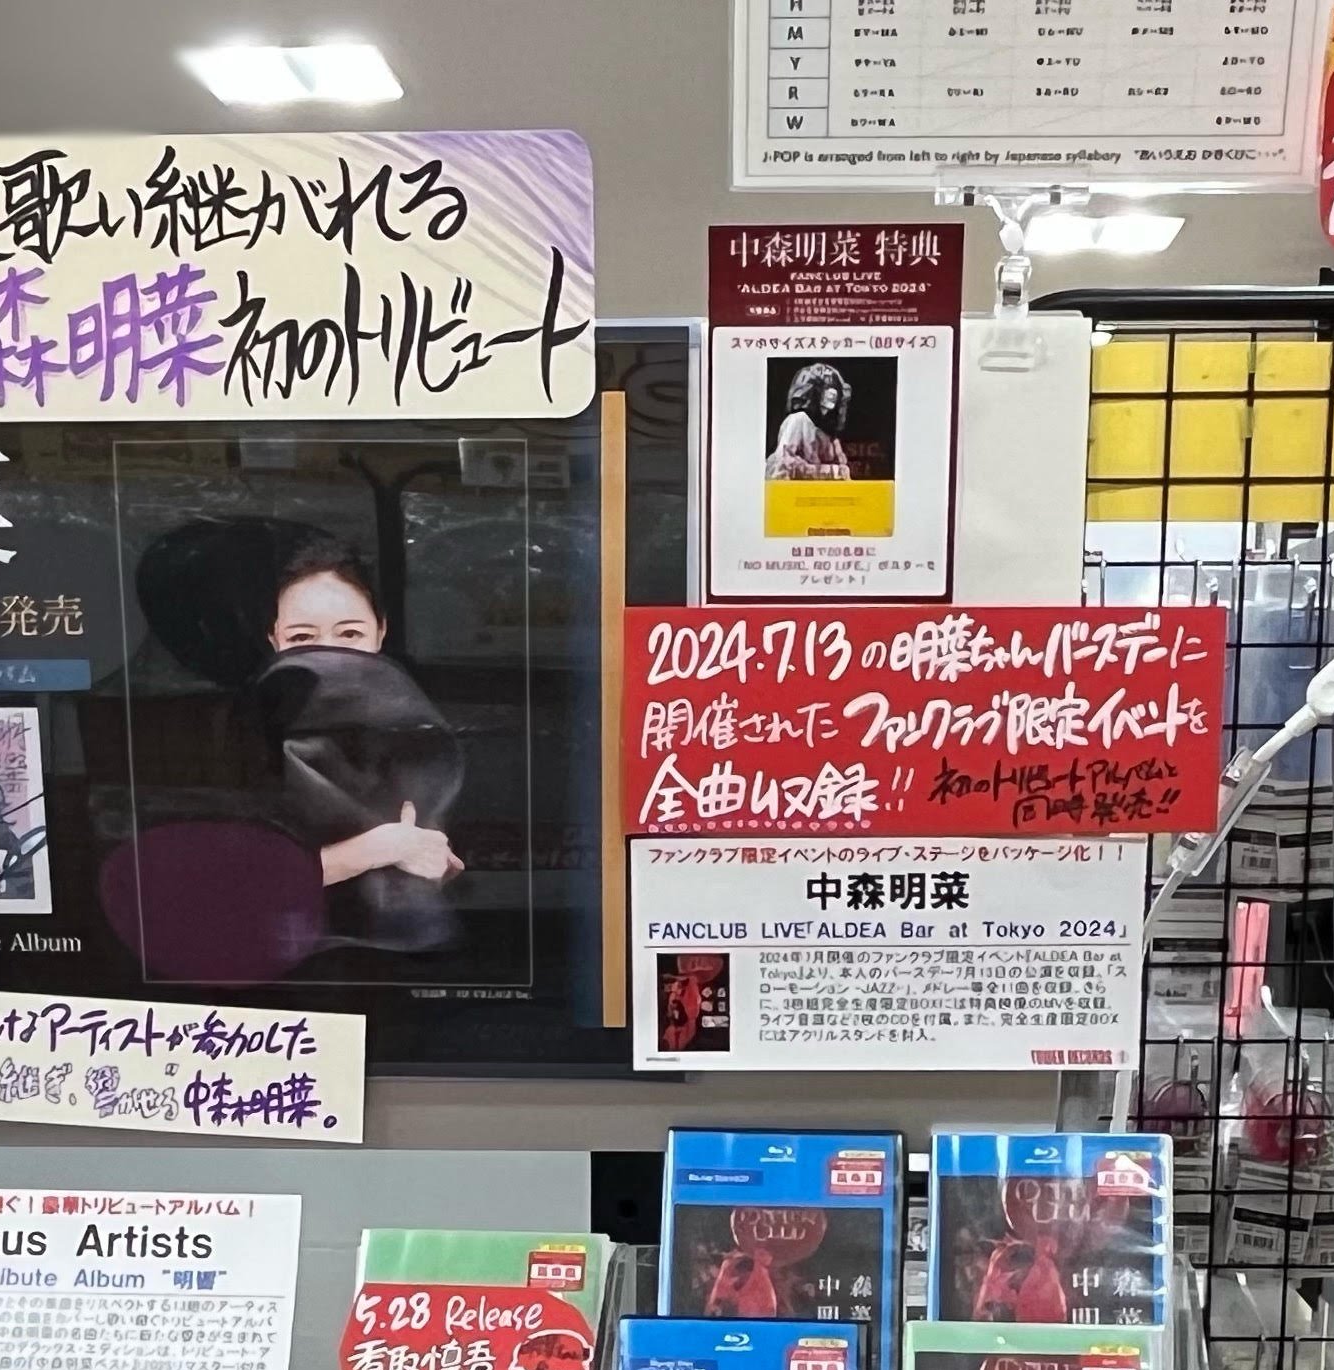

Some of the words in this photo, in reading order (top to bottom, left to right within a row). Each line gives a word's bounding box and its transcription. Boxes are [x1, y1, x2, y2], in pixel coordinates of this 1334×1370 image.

[786, 26, 803, 41] M
[785, 114, 804, 130] W
[730, 230, 862, 267] 中森明菜
[874, 230, 942, 266] 特典
[805, 871, 972, 912] 中森明菜
[648, 922, 748, 940] FANCLUB
[900, 922, 936, 939] Bar
[949, 922, 968, 939] at
[982, 921, 1046, 940] Tokyo
[10, 932, 83, 952] Album
[75, 1223, 214, 1260] Artists
[73, 1268, 146, 1289] Album
[355, 1292, 432, 1335] 5.28
[445, 1295, 544, 1336] Release
